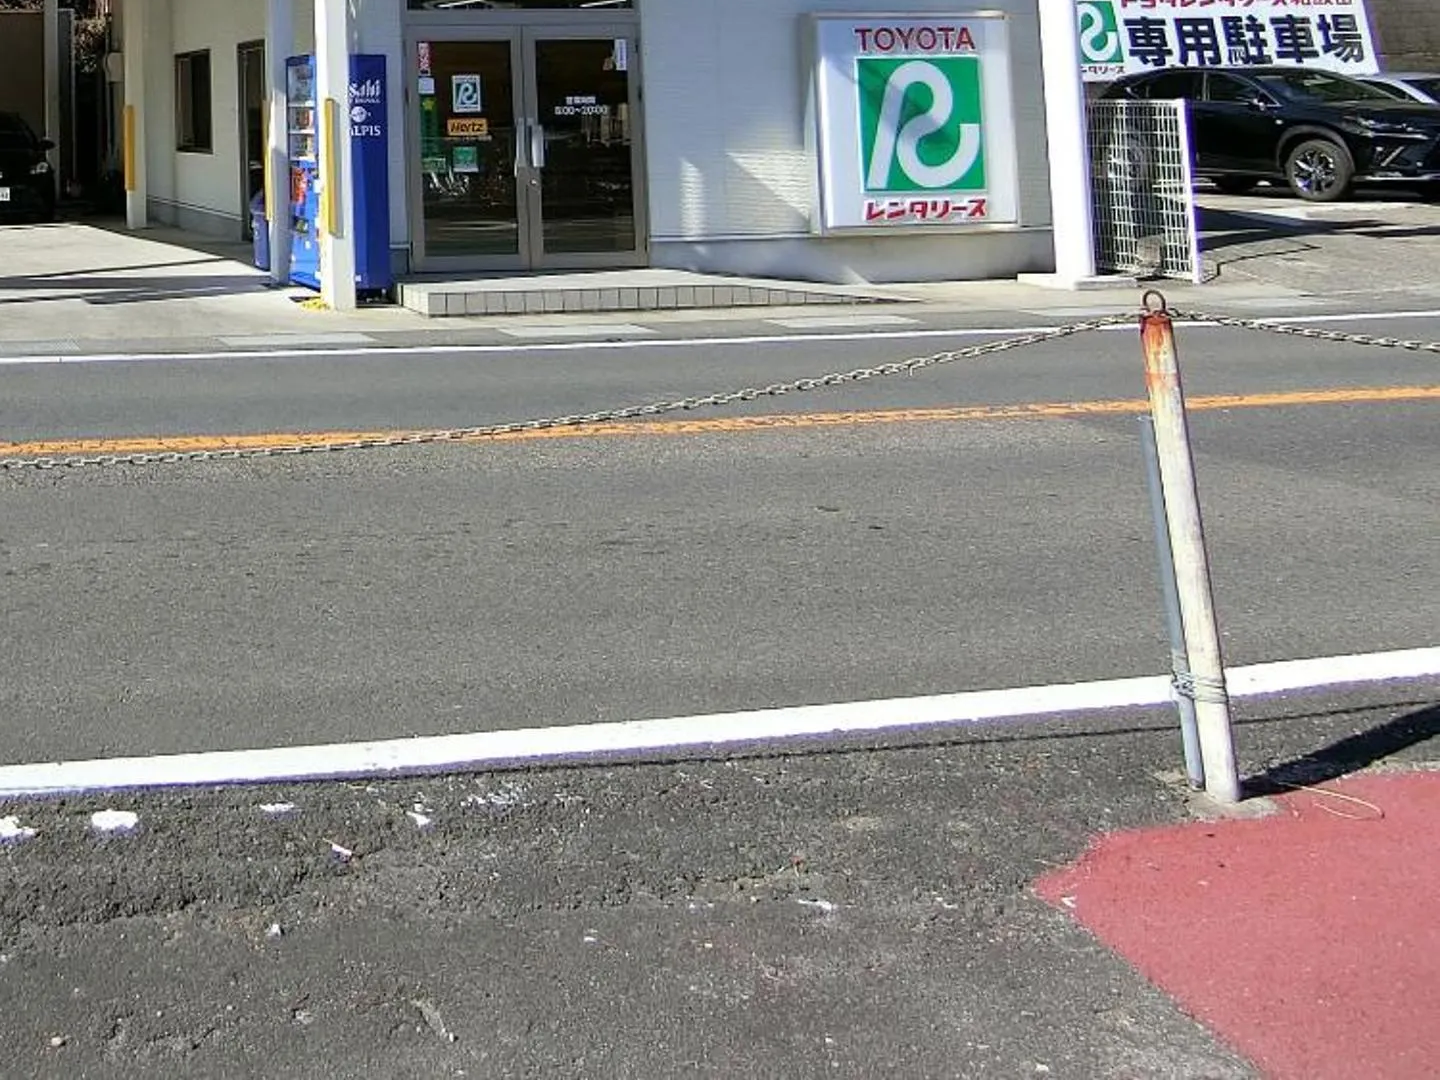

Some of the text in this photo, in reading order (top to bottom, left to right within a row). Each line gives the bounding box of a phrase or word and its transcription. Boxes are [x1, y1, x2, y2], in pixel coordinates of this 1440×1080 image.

[854, 26, 976, 51] TOYOTA
[1123, 14, 1365, 67] 専用駐車場
[450, 121, 484, 133] Hertz
[866, 198, 987, 220] レンタリース
